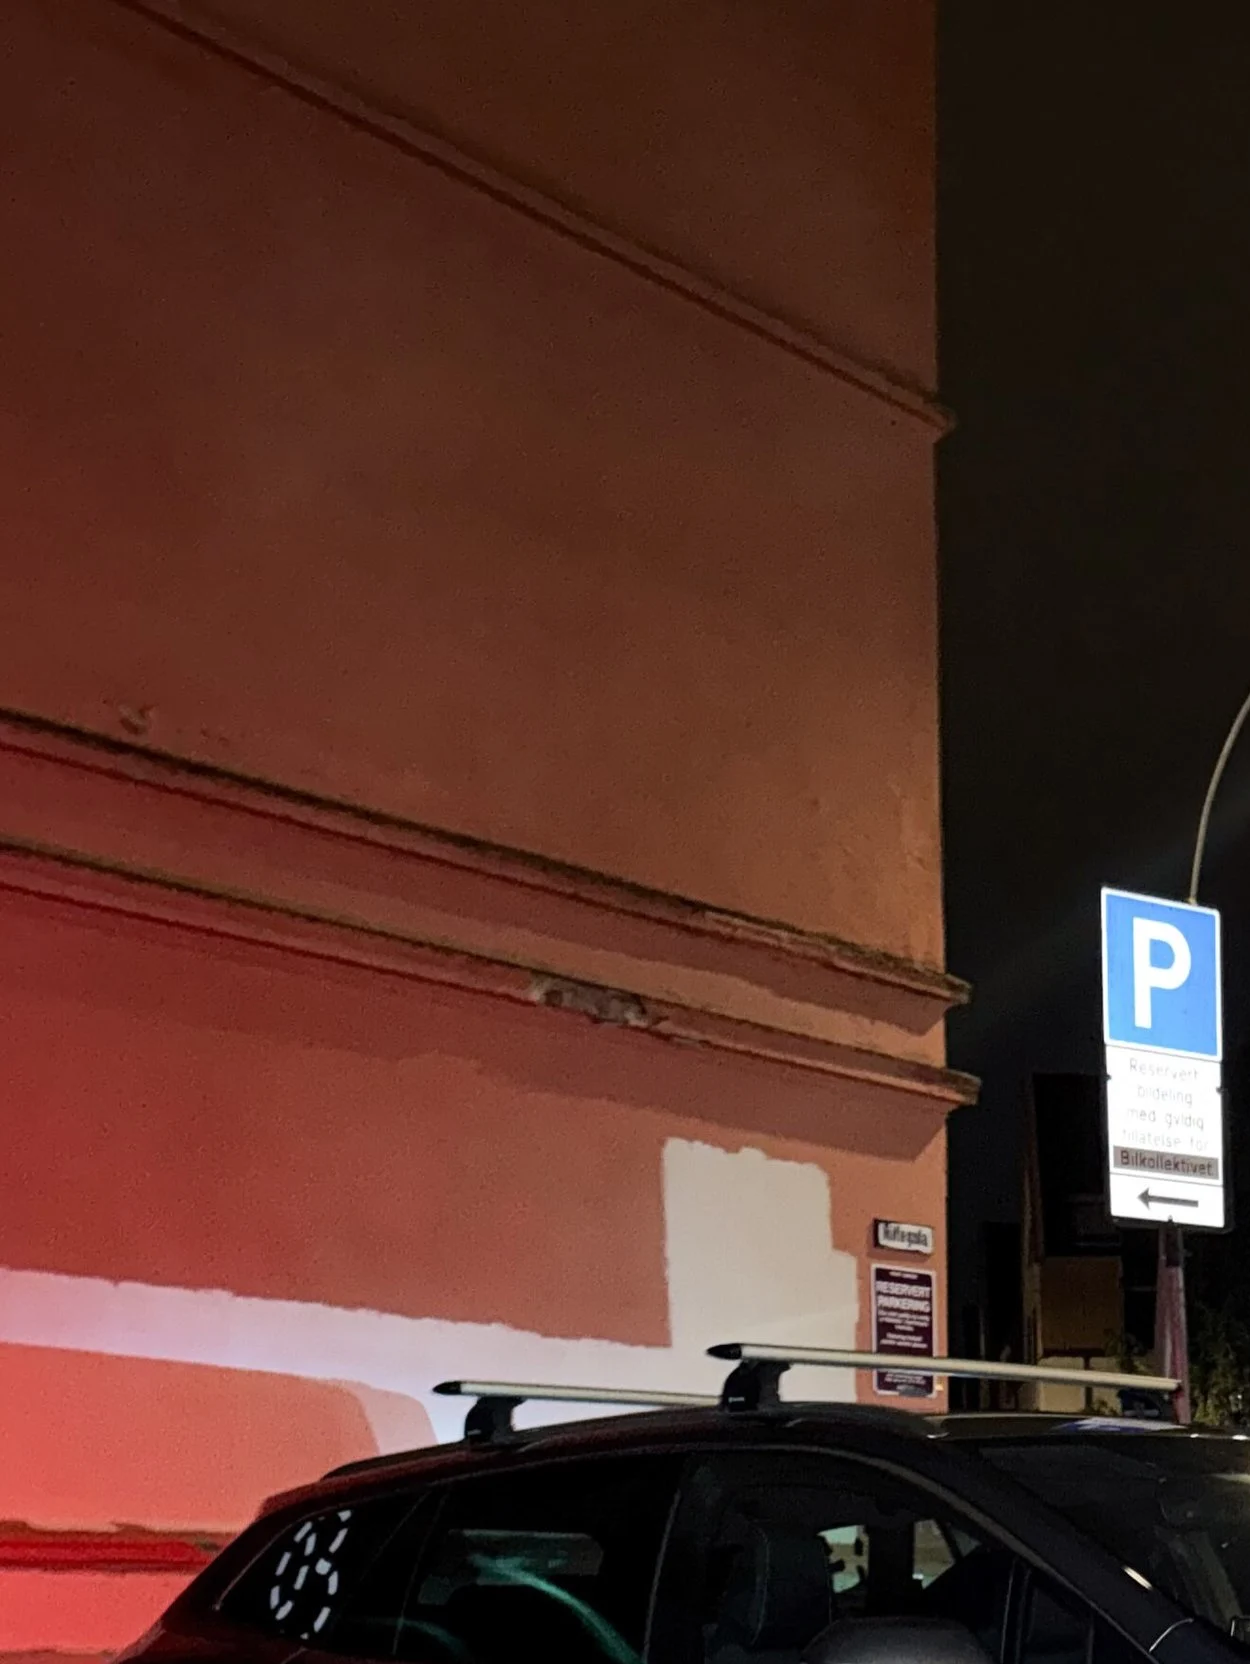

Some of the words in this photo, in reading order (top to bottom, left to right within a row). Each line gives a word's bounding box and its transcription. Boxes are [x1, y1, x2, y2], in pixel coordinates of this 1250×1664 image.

[1133, 916, 1192, 1029] P
[1129, 1057, 1200, 1082] Reservert
[1137, 1083, 1193, 1108] bildeling
[1126, 1107, 1157, 1123] med
[1120, 1150, 1213, 1176] Bilkollektivet
